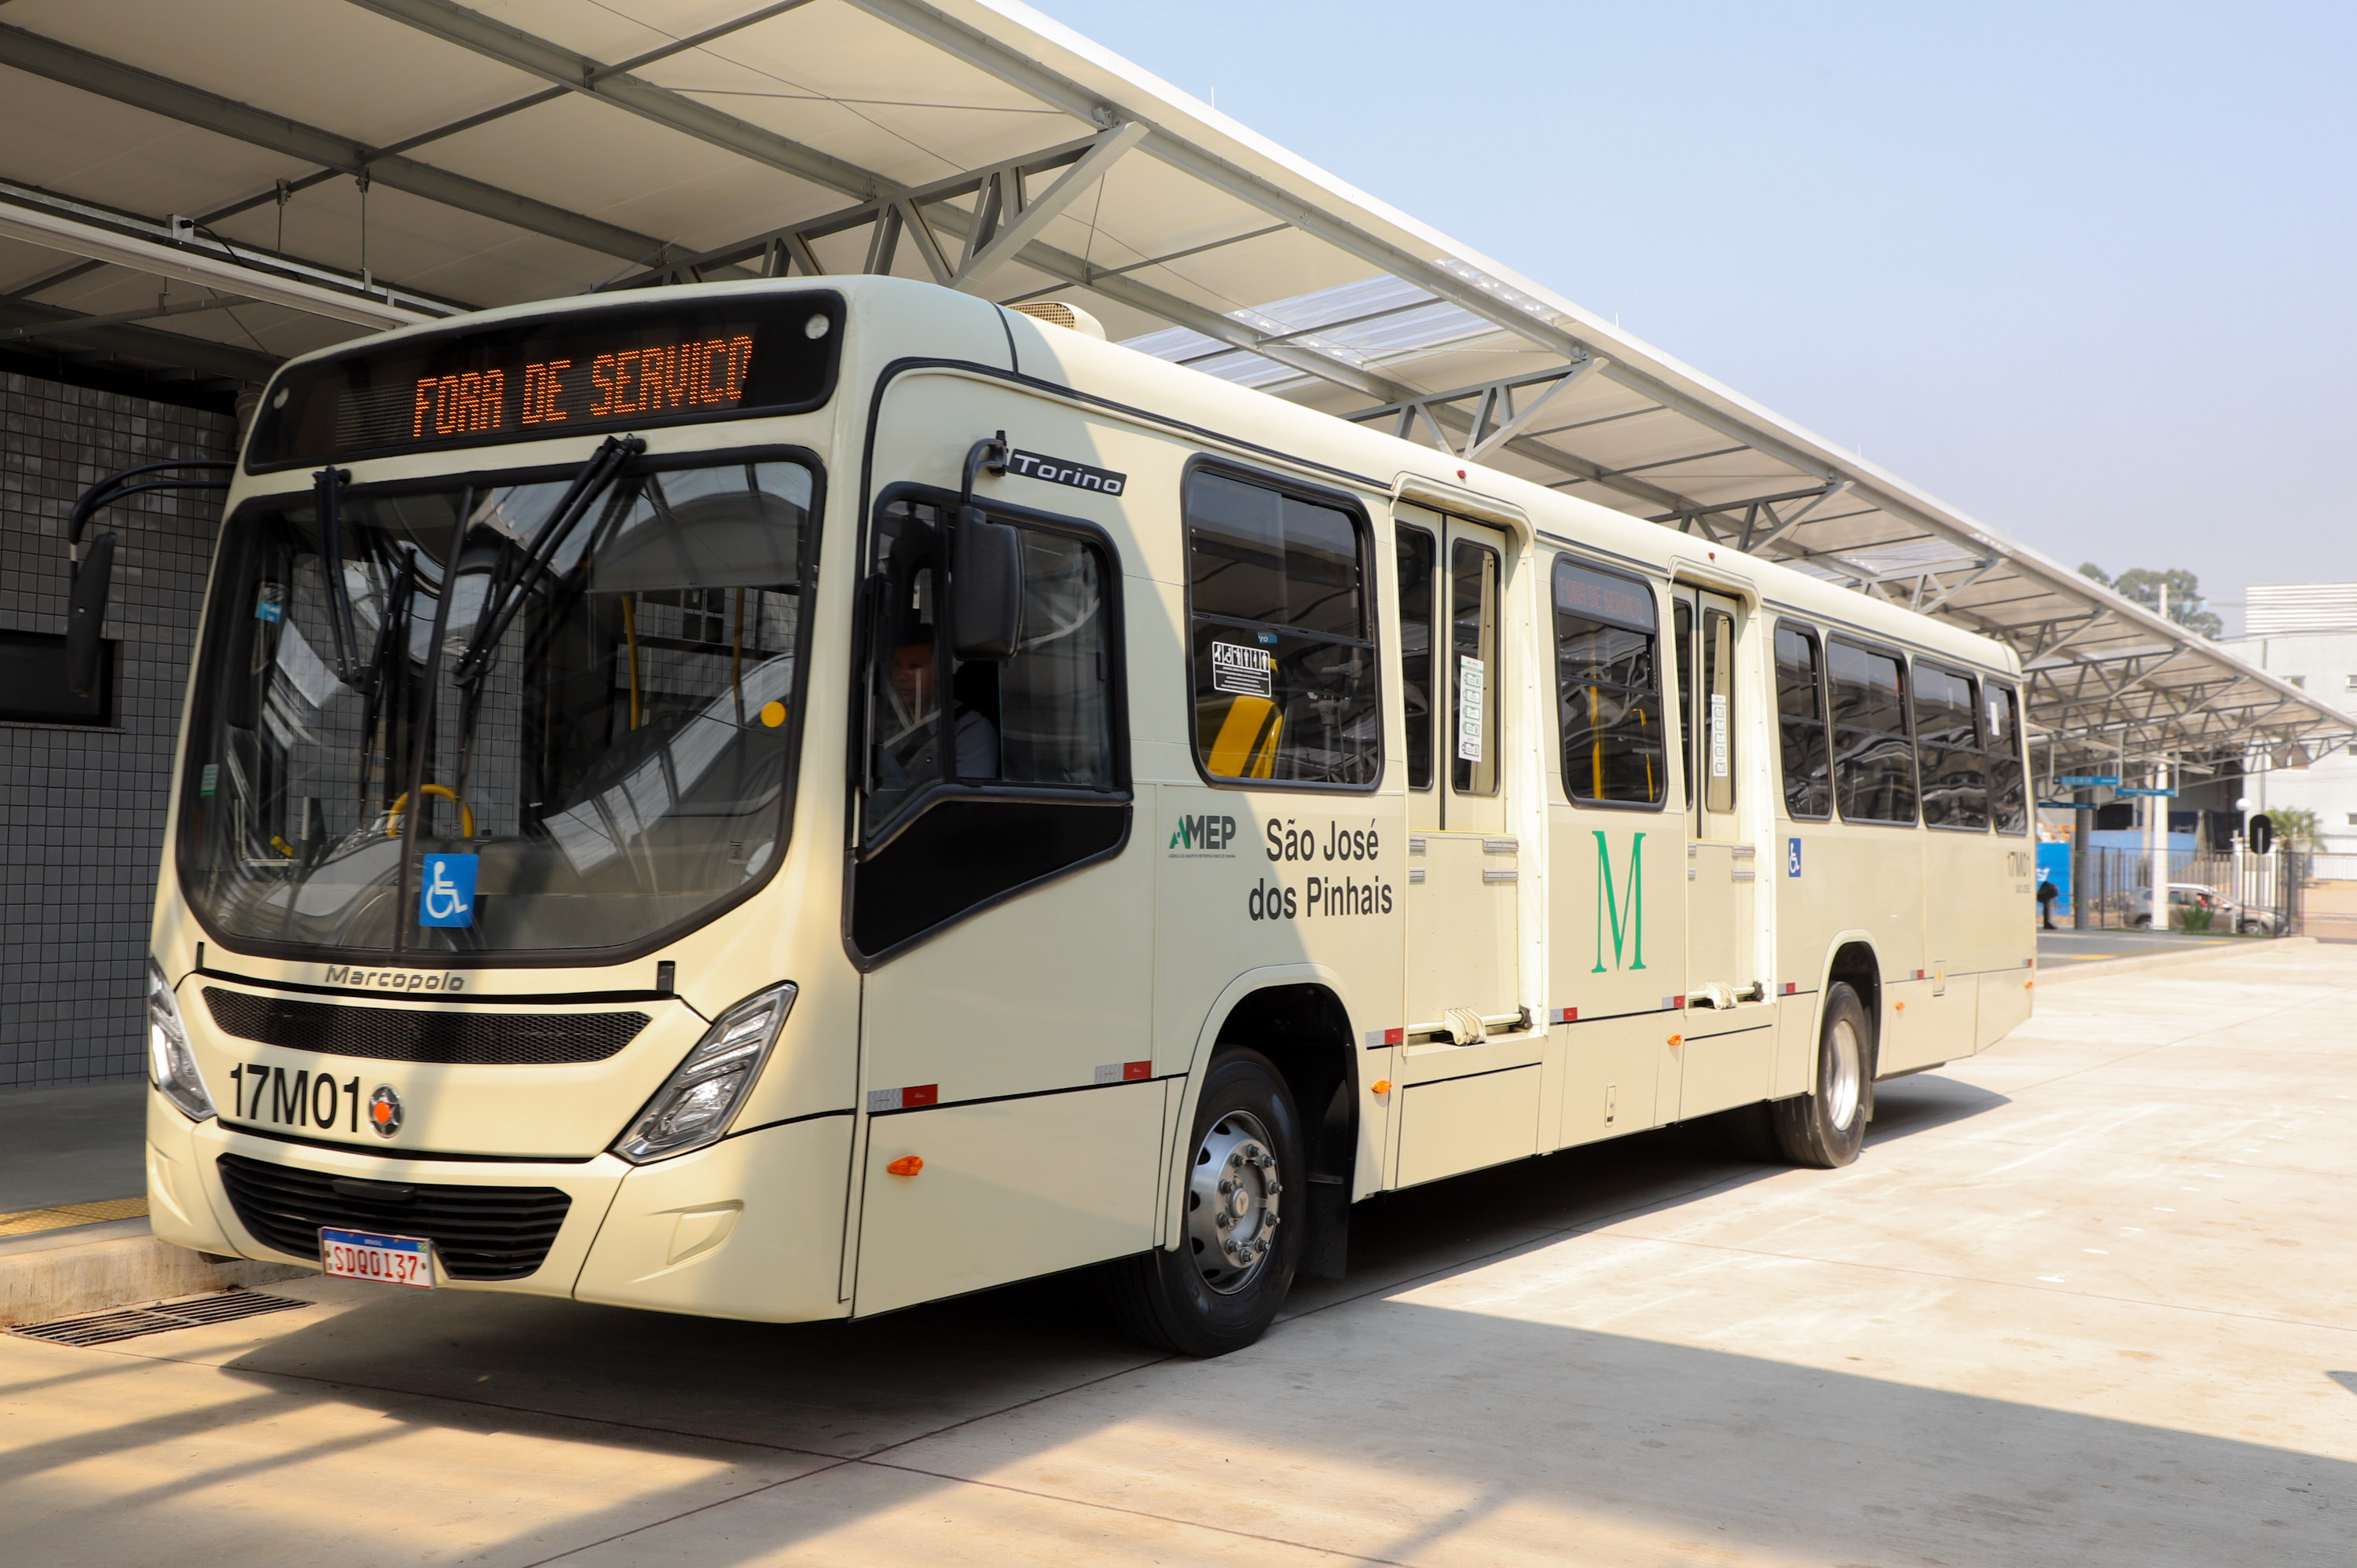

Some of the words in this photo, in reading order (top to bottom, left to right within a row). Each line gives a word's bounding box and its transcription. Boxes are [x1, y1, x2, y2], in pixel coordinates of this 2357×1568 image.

[412, 369, 504, 437] FORA
[522, 360, 571, 424] DE
[1014, 454, 1122, 493] Torino
[1169, 815, 1237, 849] AMEP
[1266, 818, 1314, 862] São
[1323, 818, 1379, 861] José
[1248, 877, 1297, 921] dos
[1307, 875, 1393, 918] Pinhais
[1591, 830, 1647, 973] M
[325, 965, 465, 992] Marcopolo
[229, 1062, 360, 1133] 17M01
